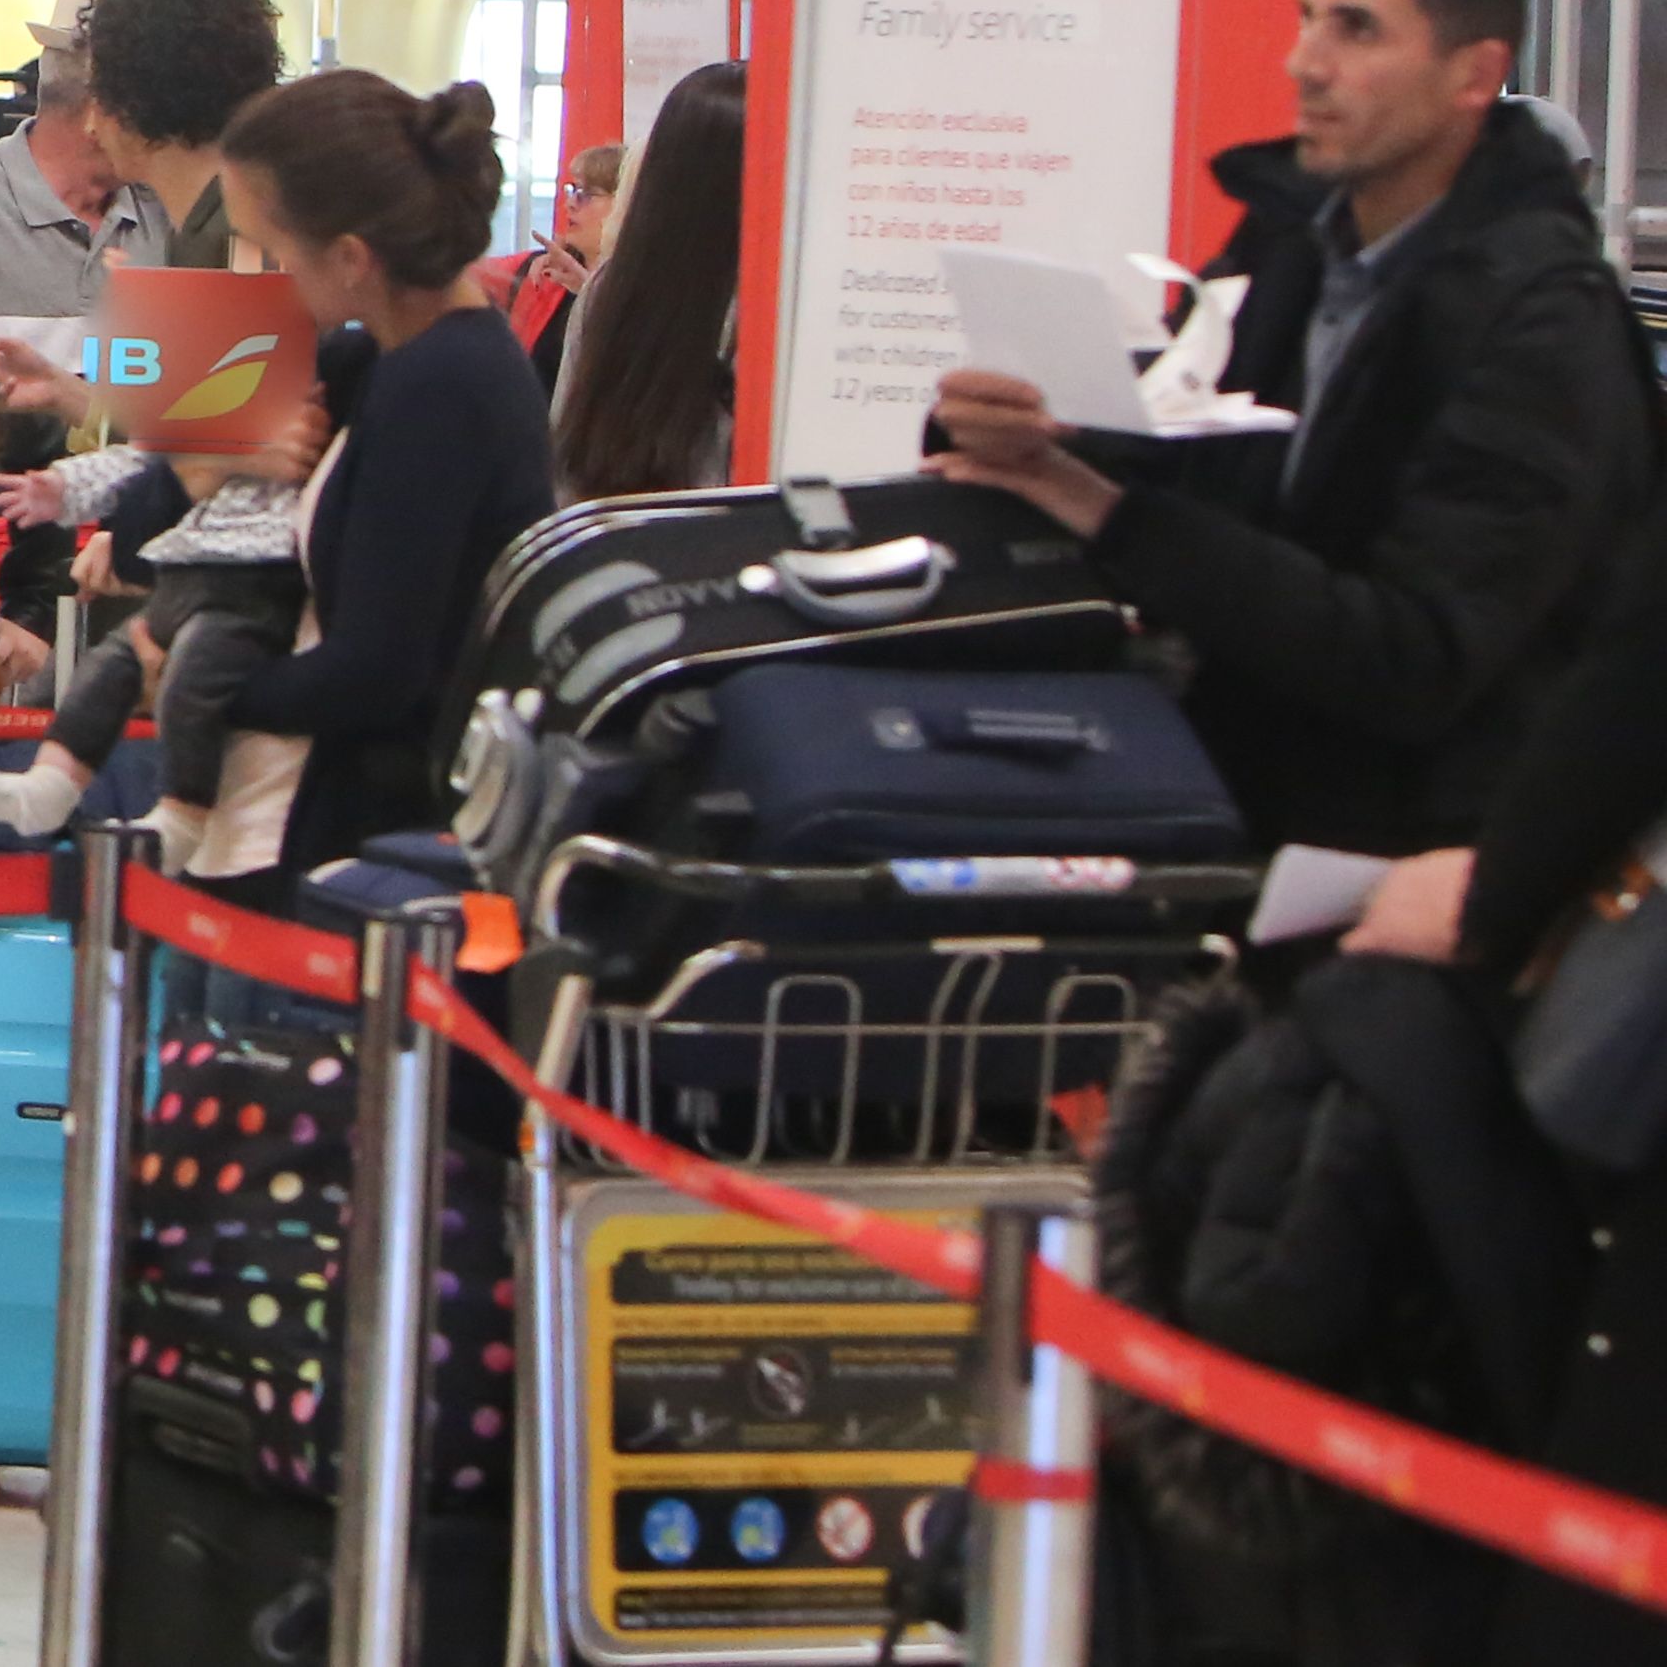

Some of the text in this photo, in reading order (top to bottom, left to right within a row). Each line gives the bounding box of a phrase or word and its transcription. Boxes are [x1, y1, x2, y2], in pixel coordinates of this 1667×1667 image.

[859, 0, 1076, 50] Family service
[847, 213, 874, 237] 12
[926, 217, 951, 241] de
[82, 336, 163, 385] IB
